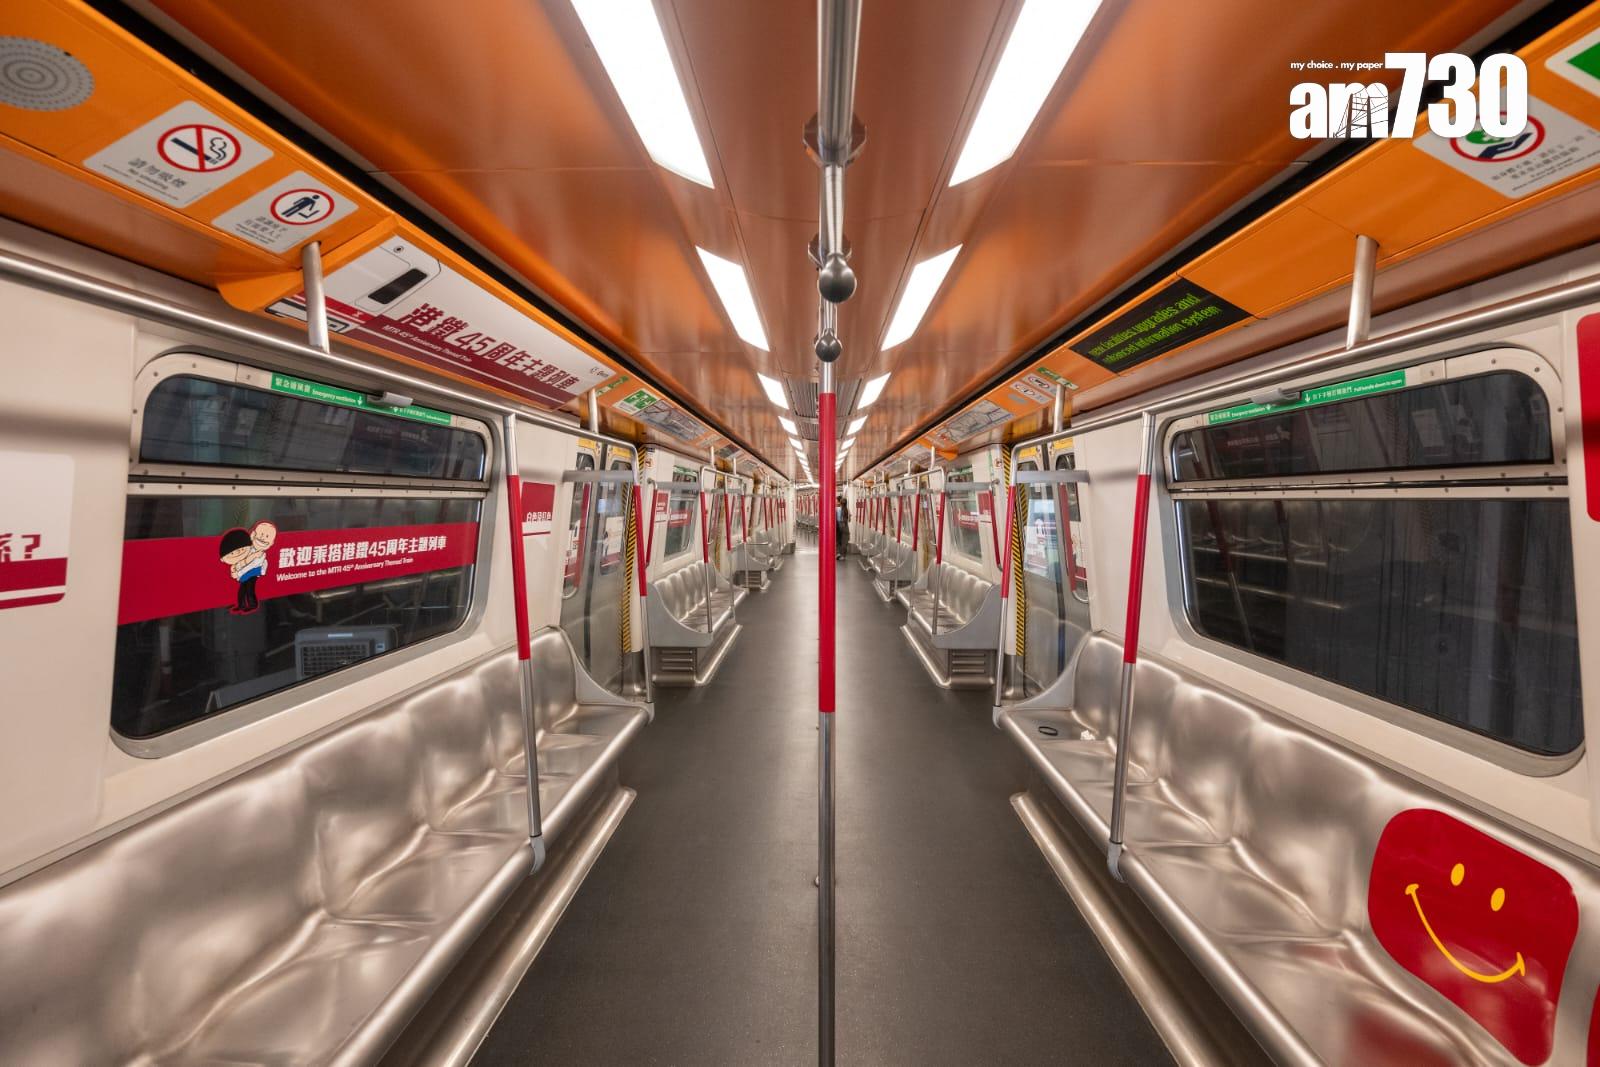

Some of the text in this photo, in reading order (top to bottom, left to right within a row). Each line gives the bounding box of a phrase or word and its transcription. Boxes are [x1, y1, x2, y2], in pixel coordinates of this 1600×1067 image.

[1133, 306, 1179, 332] upgrades
[1176, 293, 1201, 310] and
[1181, 306, 1221, 326] system
[401, 302, 580, 390] 港鐵45周年主題列車
[279, 535, 447, 569] 歡迎乘搭港鐵45周年主題列車
[276, 572, 308, 582] Welcome
[316, 568, 327, 576] the
[327, 565, 342, 574] MTR
[354, 561, 385, 571] Anniversary
